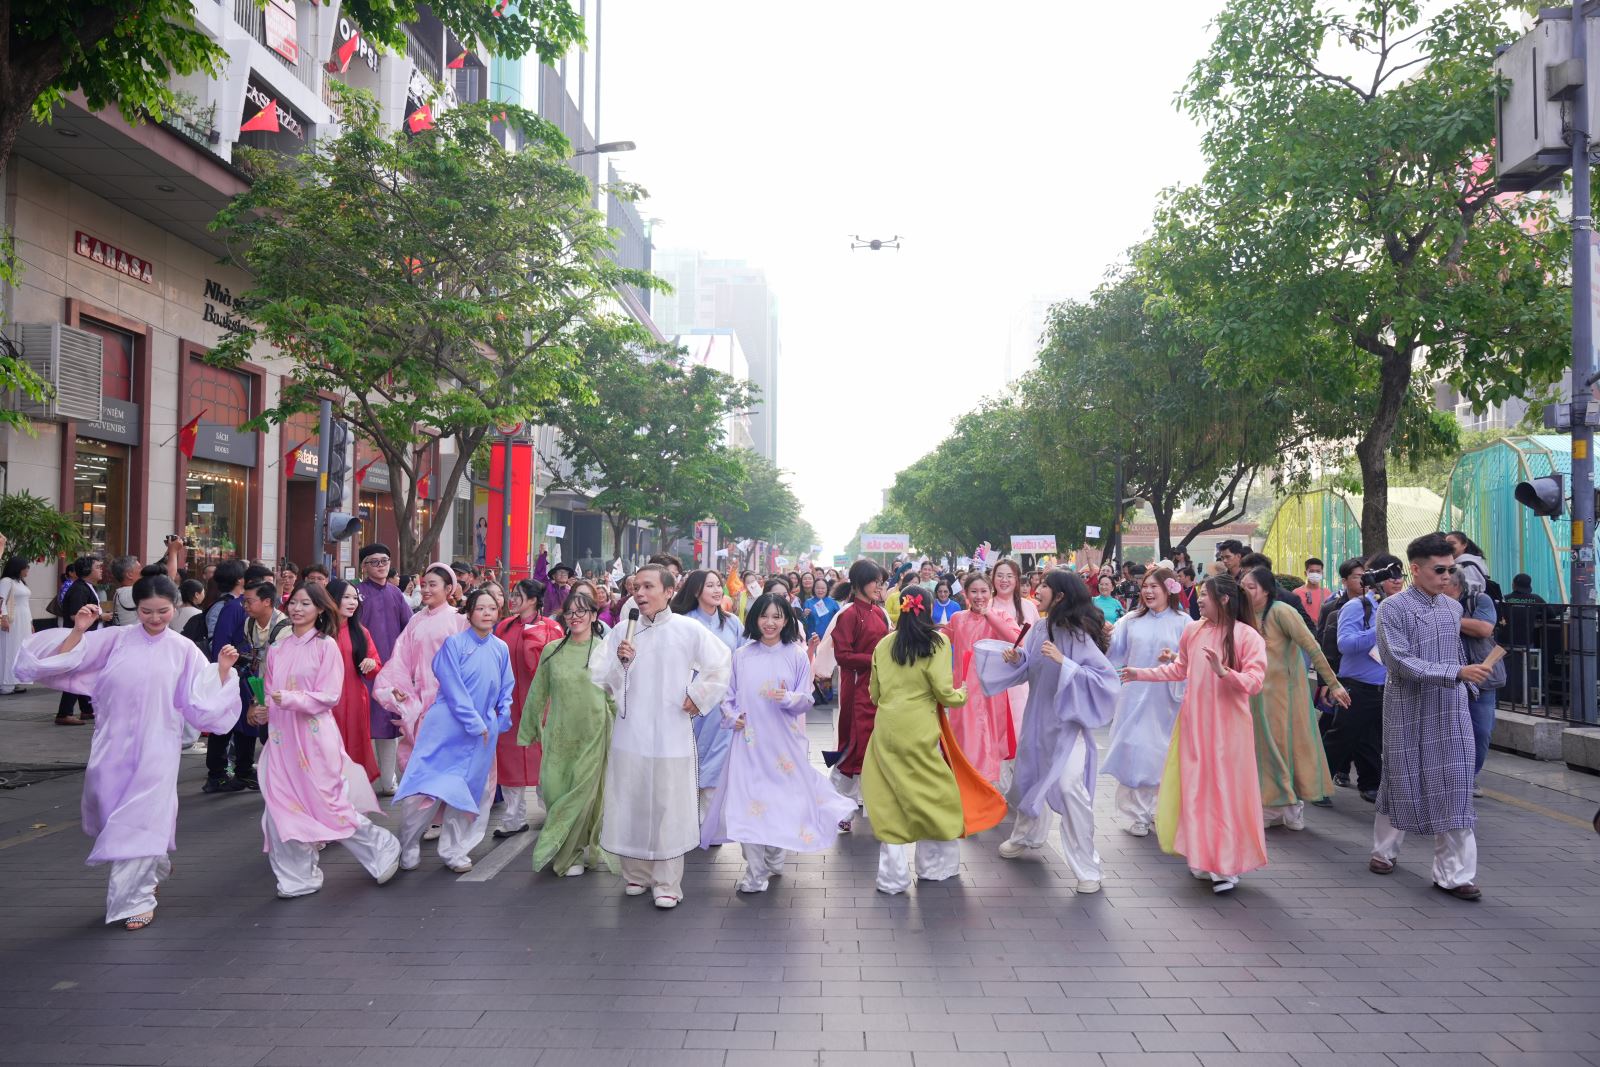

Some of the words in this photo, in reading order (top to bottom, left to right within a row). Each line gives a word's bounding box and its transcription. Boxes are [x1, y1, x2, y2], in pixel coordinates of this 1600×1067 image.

[79, 233, 153, 284] FAHASA
[203, 278, 231, 306] Nhà
[302, 449, 318, 466] faha
